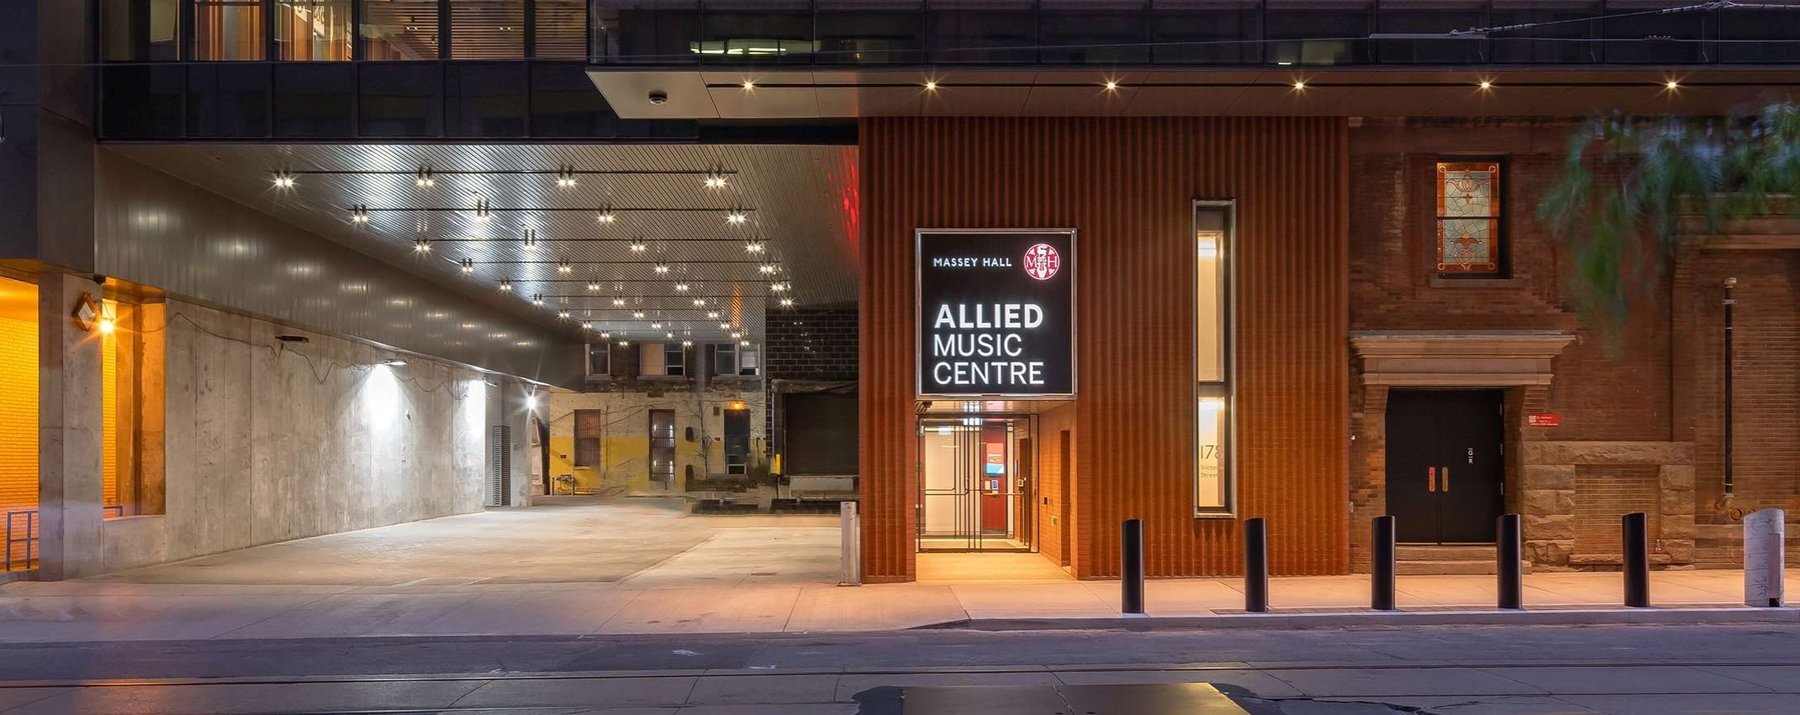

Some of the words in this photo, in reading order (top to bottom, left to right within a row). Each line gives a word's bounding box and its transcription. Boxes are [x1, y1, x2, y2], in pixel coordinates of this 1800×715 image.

[933, 257, 978, 268] MASSEY
[982, 257, 1012, 268] HALL
[934, 303, 1044, 329] ALLIED
[934, 333, 1023, 357] MUSIC
[933, 361, 1045, 385] CENTRE
